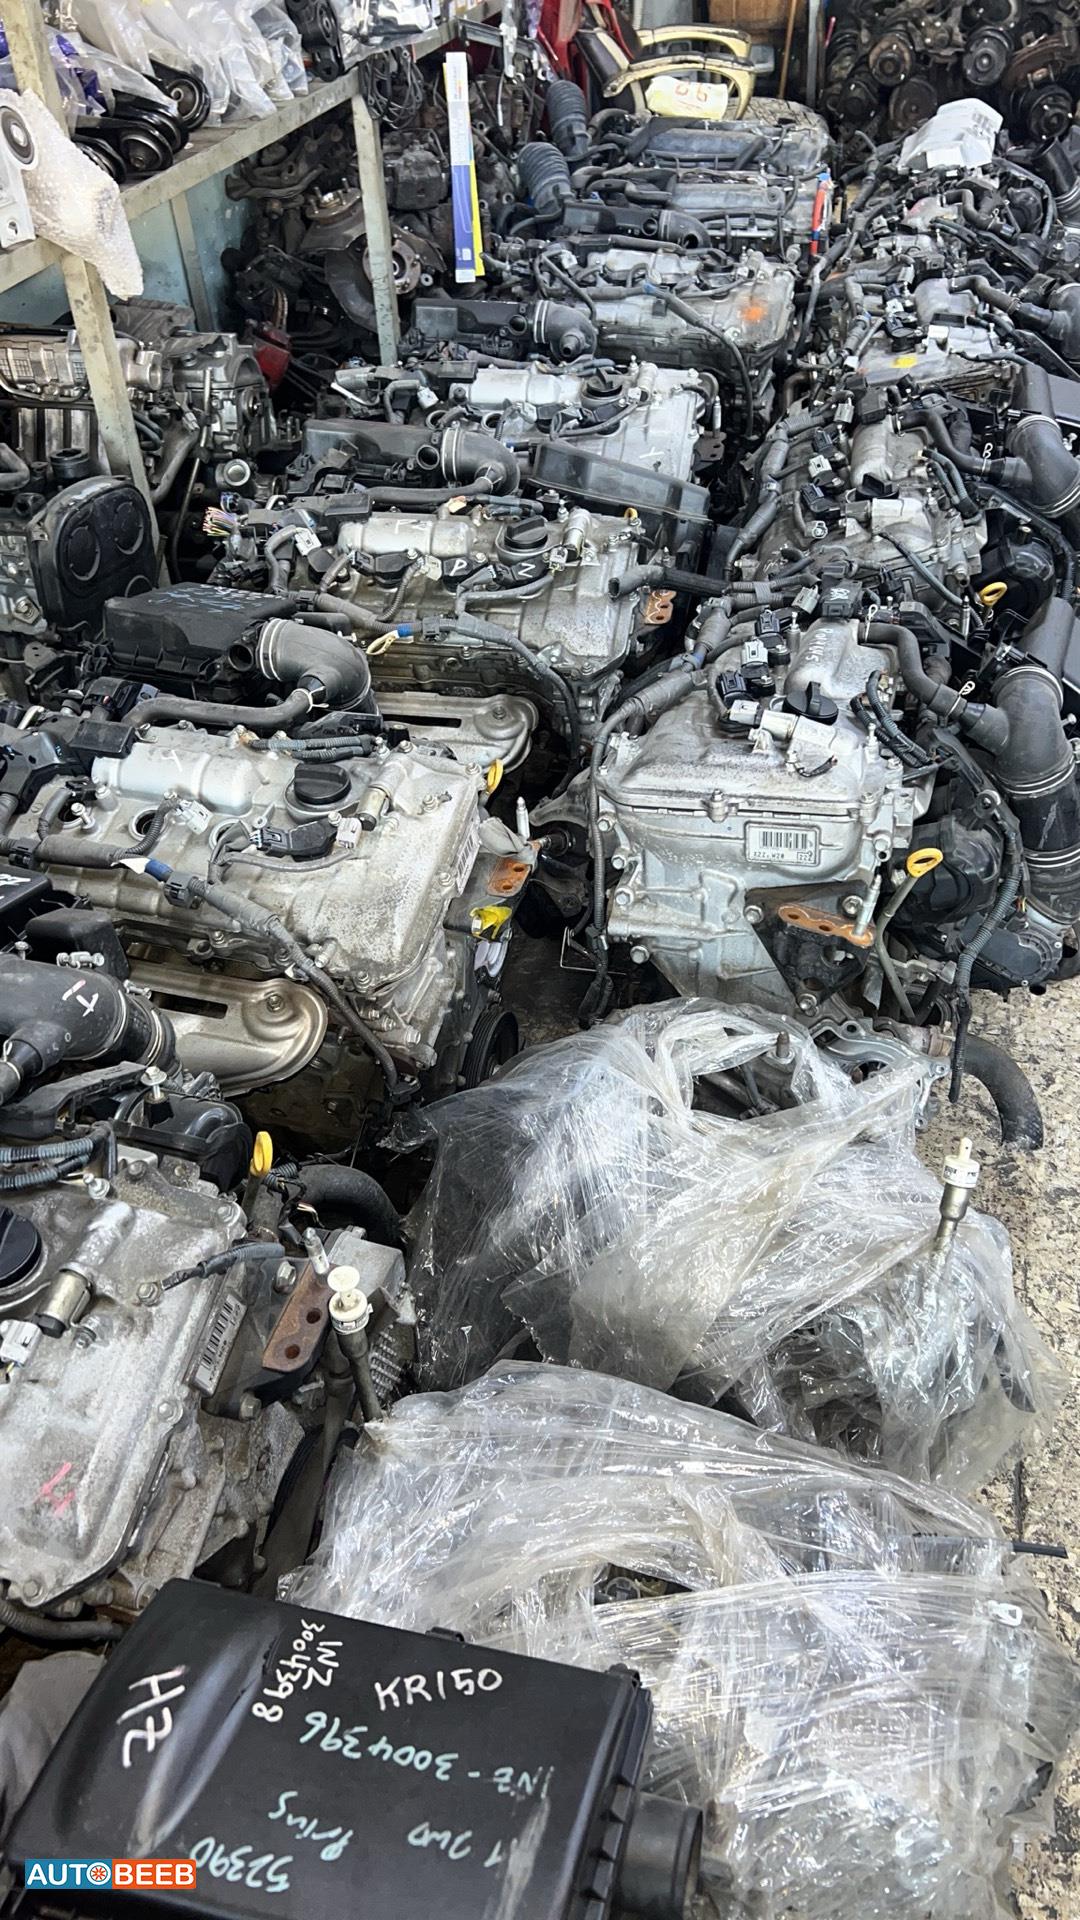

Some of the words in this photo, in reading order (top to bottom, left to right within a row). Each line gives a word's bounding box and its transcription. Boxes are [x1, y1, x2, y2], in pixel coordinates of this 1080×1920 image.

[449, 558, 467, 577] P
[252, 1619, 325, 1722] 3004398
[374, 1668, 503, 1711] KR150
[300, 1711, 459, 1781] 3004396
[268, 1791, 353, 1861] Prius
[189, 1836, 294, 1892] 52390
